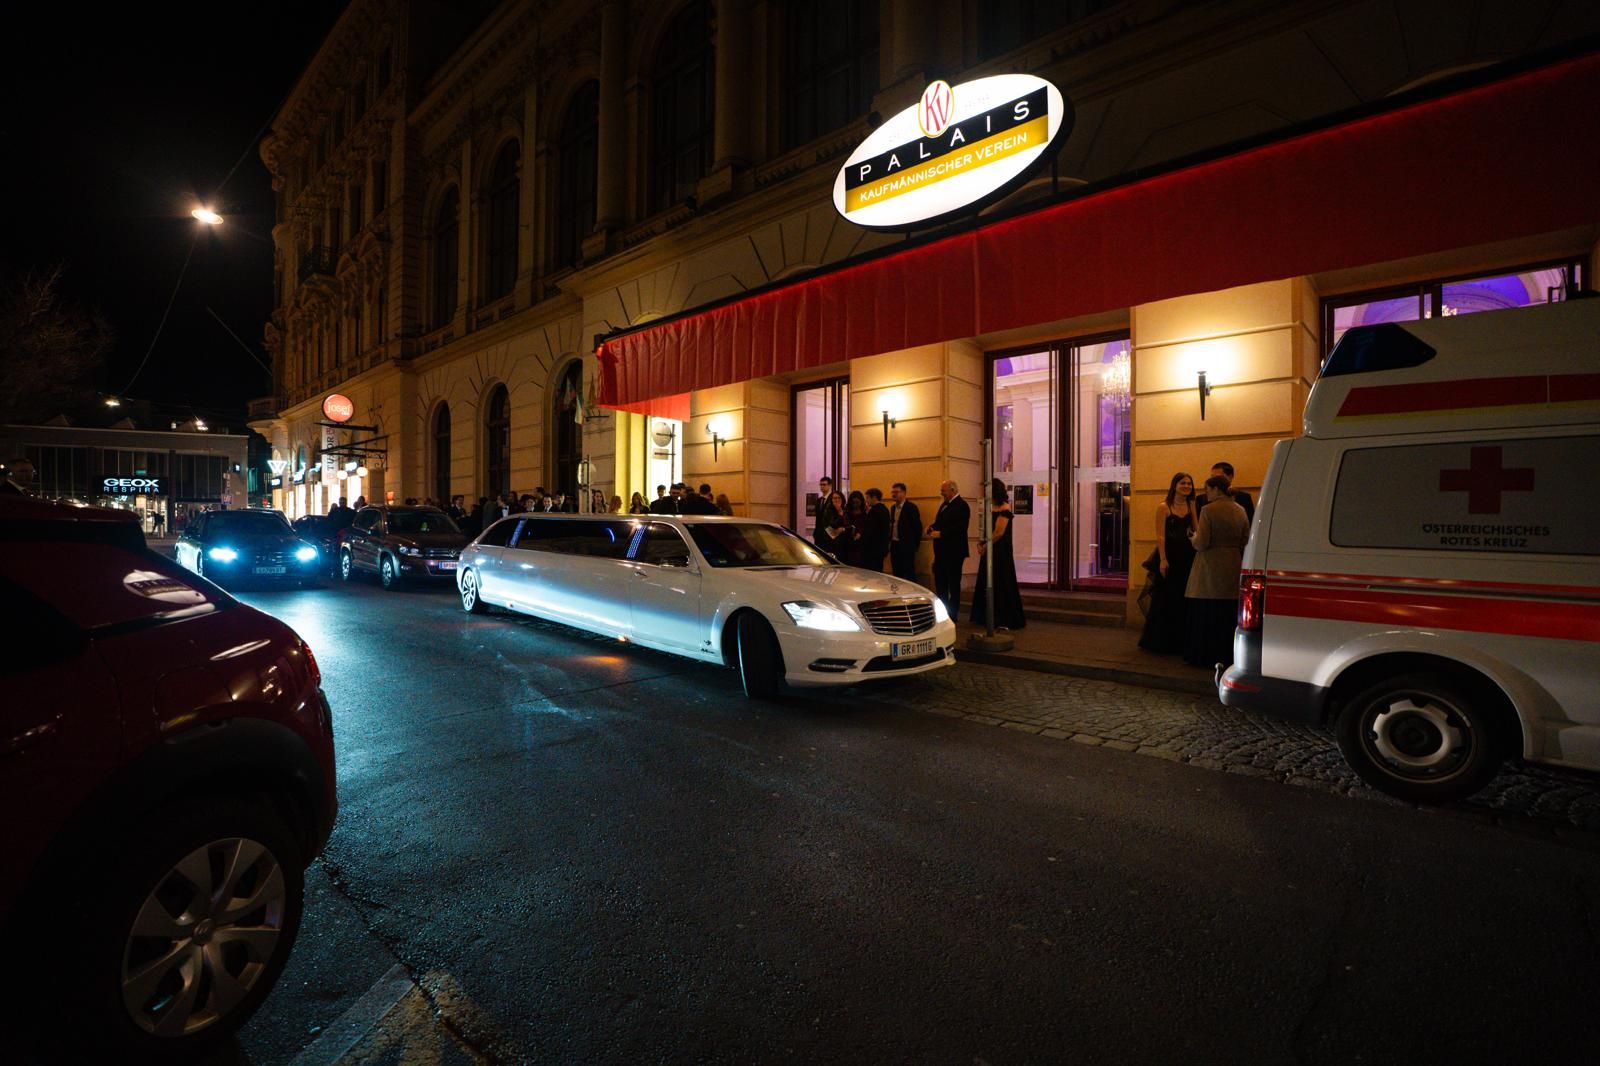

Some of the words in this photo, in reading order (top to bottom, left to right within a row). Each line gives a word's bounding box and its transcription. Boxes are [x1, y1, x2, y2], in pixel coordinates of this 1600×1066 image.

[860, 101, 1030, 181] PALAIS
[860, 154, 973, 202] KAUFMÄNNISCHER
[975, 131, 1028, 161] VEREIN
[103, 478, 160, 487] GEOX
[1422, 523, 1550, 536] ÖSTERREICHISCHES
[1440, 537, 1481, 546] ROTES
[1483, 537, 1528, 547] KREUZ
